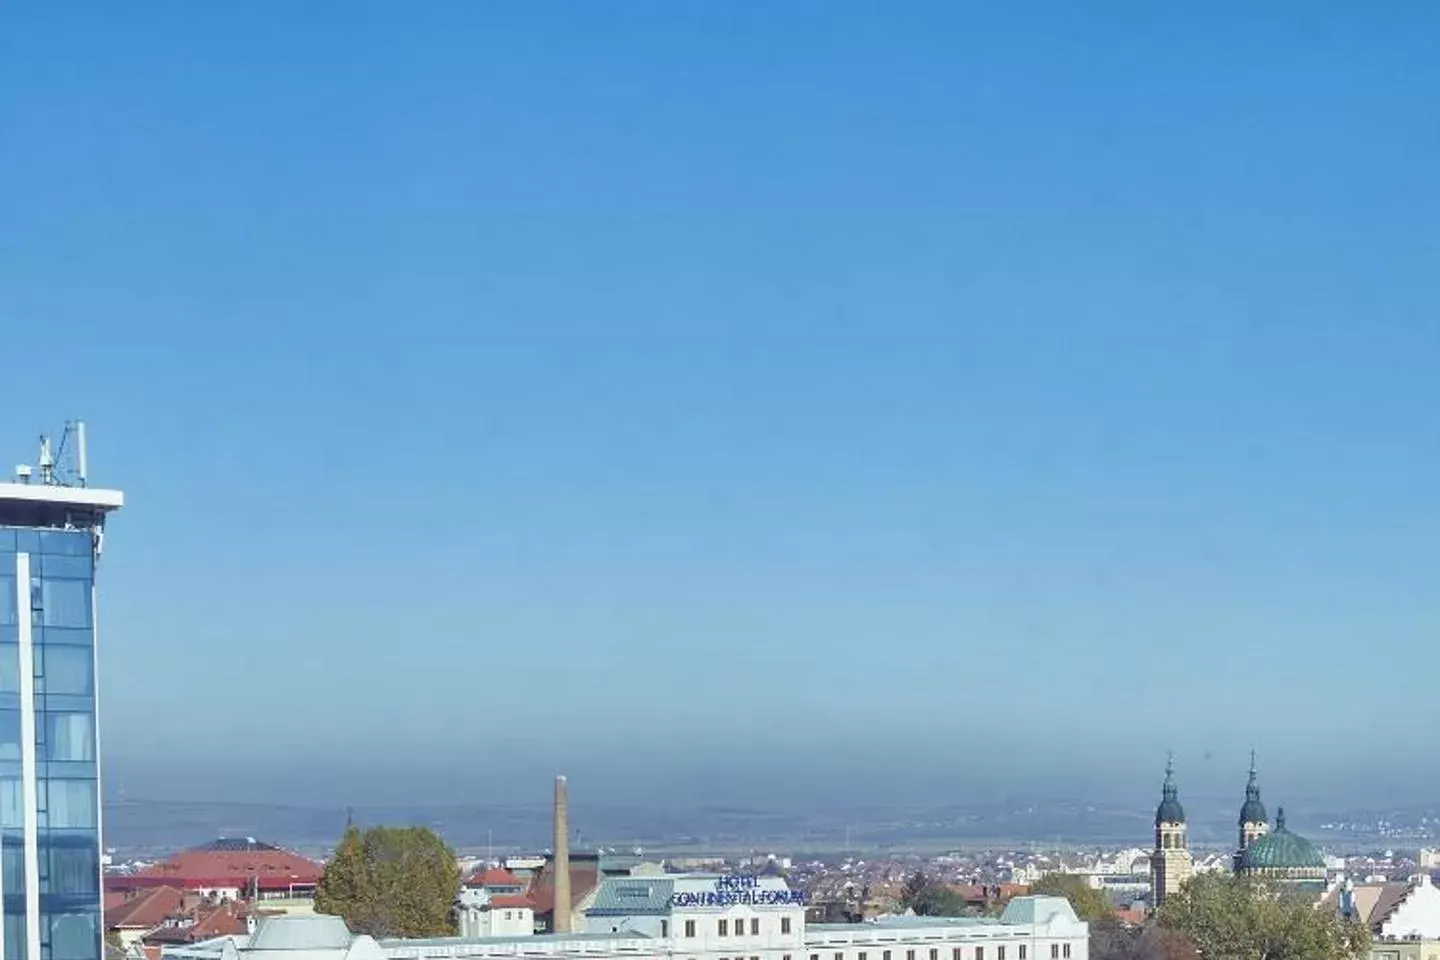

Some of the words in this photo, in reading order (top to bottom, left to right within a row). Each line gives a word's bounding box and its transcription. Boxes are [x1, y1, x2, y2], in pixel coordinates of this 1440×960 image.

[719, 875, 761, 888] HOTEL
[672, 889, 760, 906] CONTINENTAL
[761, 889, 805, 906] FORUM
